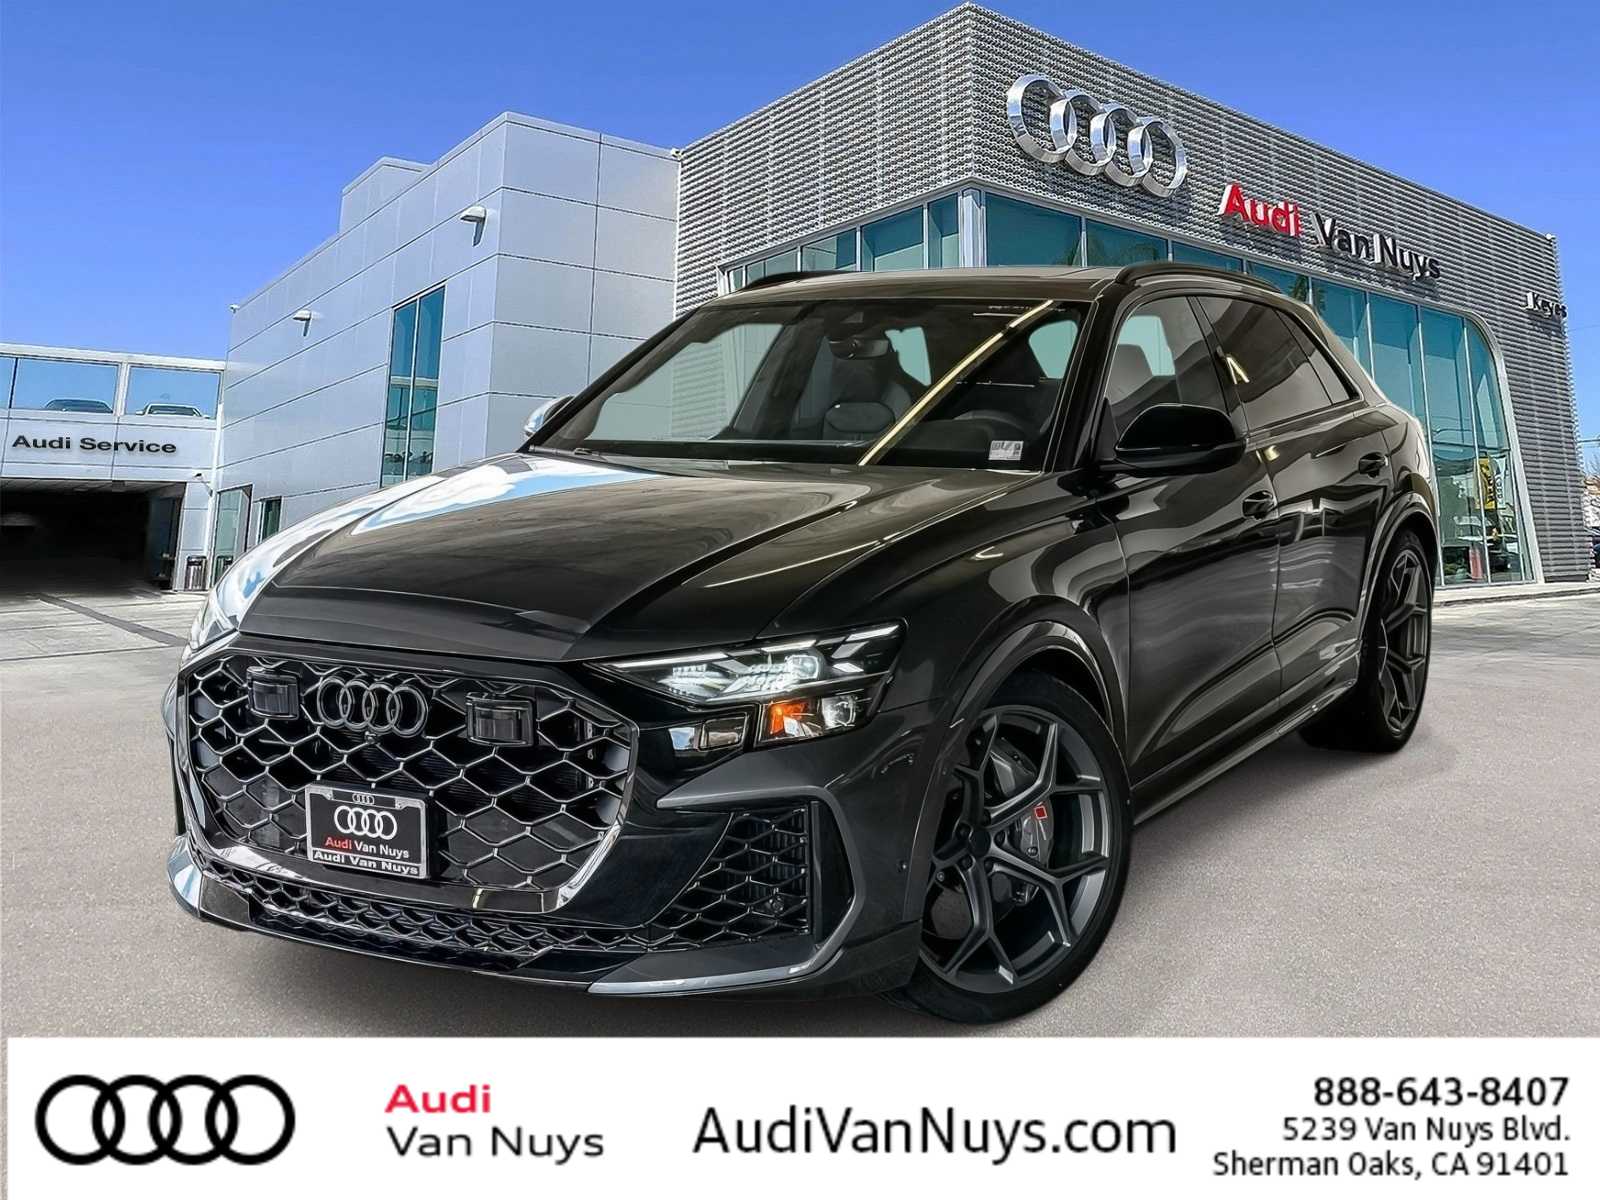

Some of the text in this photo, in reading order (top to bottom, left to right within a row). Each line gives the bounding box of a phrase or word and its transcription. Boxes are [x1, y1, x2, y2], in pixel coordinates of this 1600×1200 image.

[1217, 182, 1442, 281] Audi Van Nuys
[12, 434, 177, 454] Audi Service
[324, 836, 409, 860] Audi Van Nuys
[313, 850, 419, 876] Audi Van Nuys
